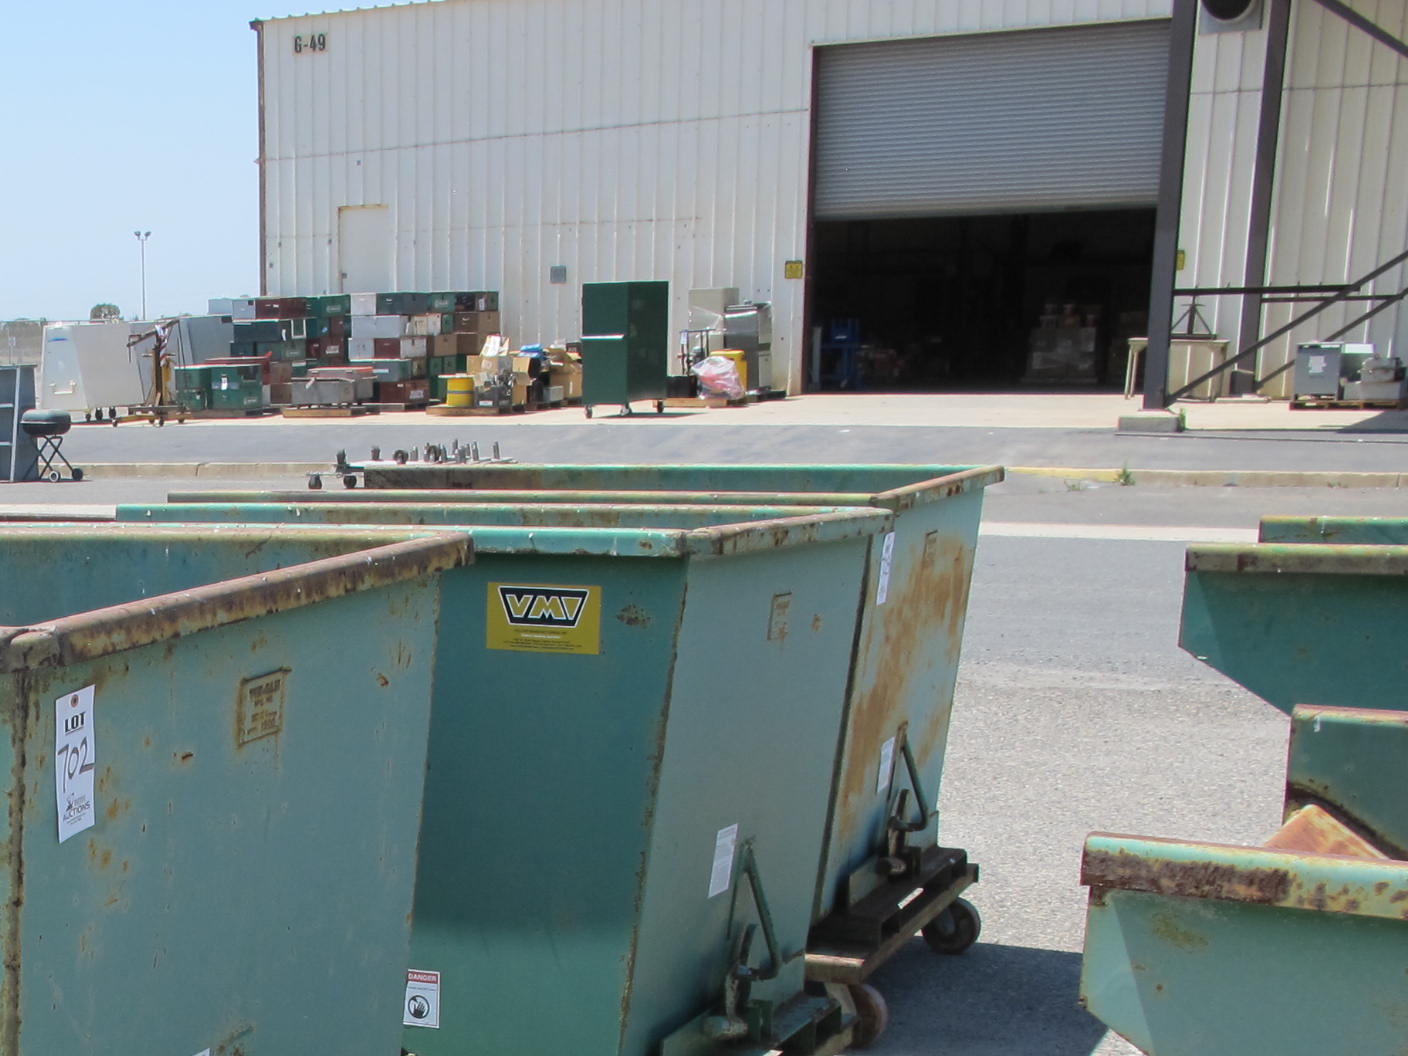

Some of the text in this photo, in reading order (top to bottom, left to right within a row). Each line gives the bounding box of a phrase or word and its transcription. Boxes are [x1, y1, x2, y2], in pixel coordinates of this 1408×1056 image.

[64, 711, 86, 733] LOT
[57, 736, 95, 794] 702
[407, 973, 437, 982] DANGER
